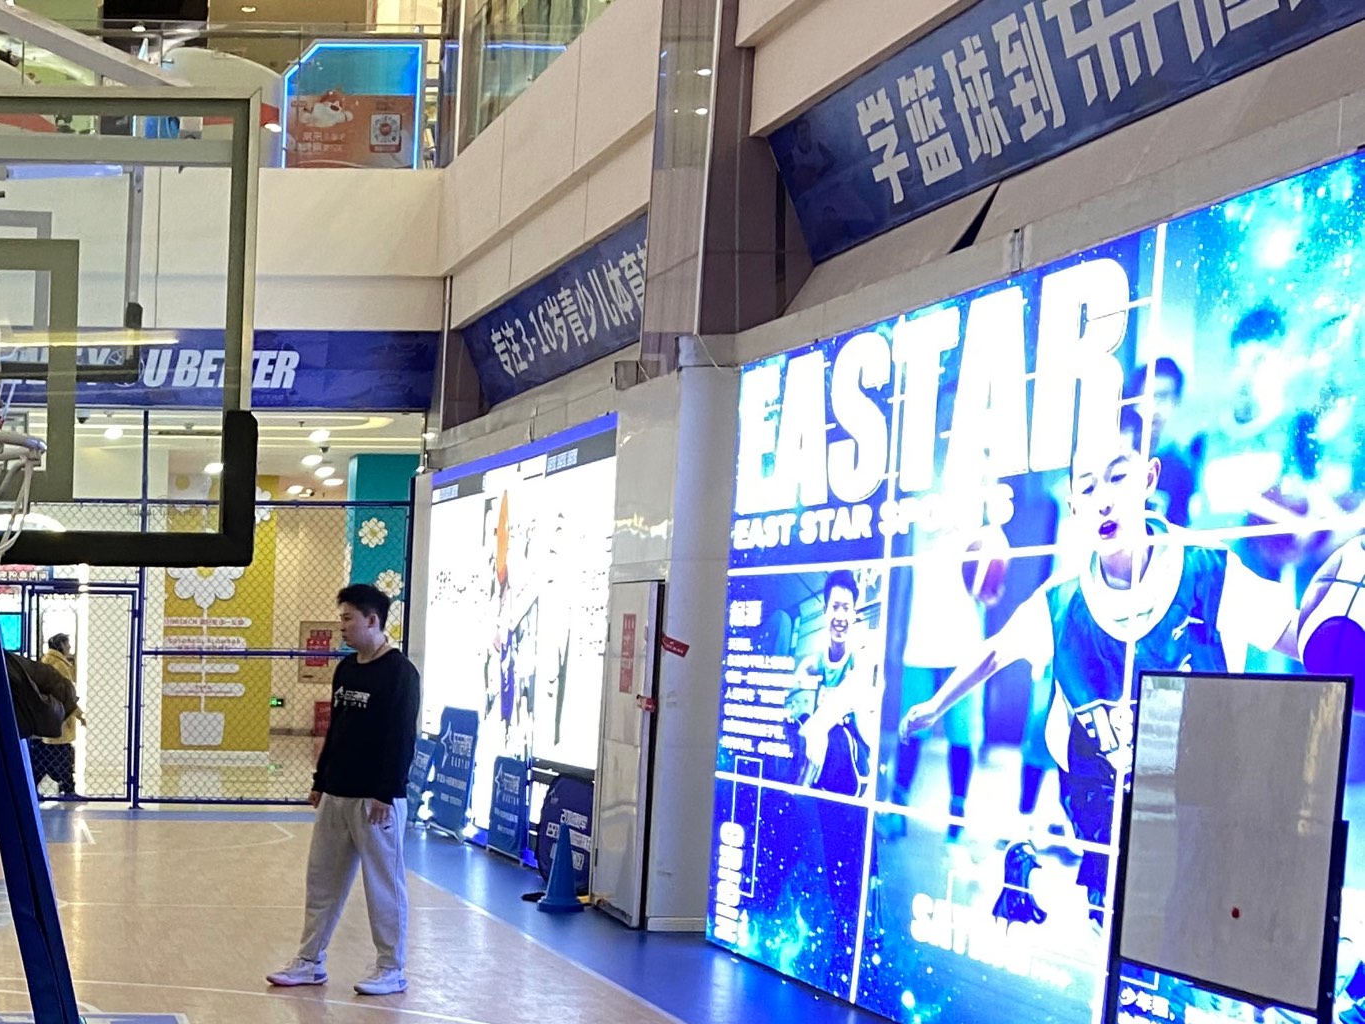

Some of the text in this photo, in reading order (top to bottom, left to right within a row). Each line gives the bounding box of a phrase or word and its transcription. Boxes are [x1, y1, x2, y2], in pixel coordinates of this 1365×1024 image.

[490, 238, 648, 378] 专注3-16岁青少儿体育
[171, 349, 300, 389] BEER
[735, 257, 1130, 516] EASTAR
[732, 515, 796, 550] EAST
[799, 505, 872, 545] STAR
